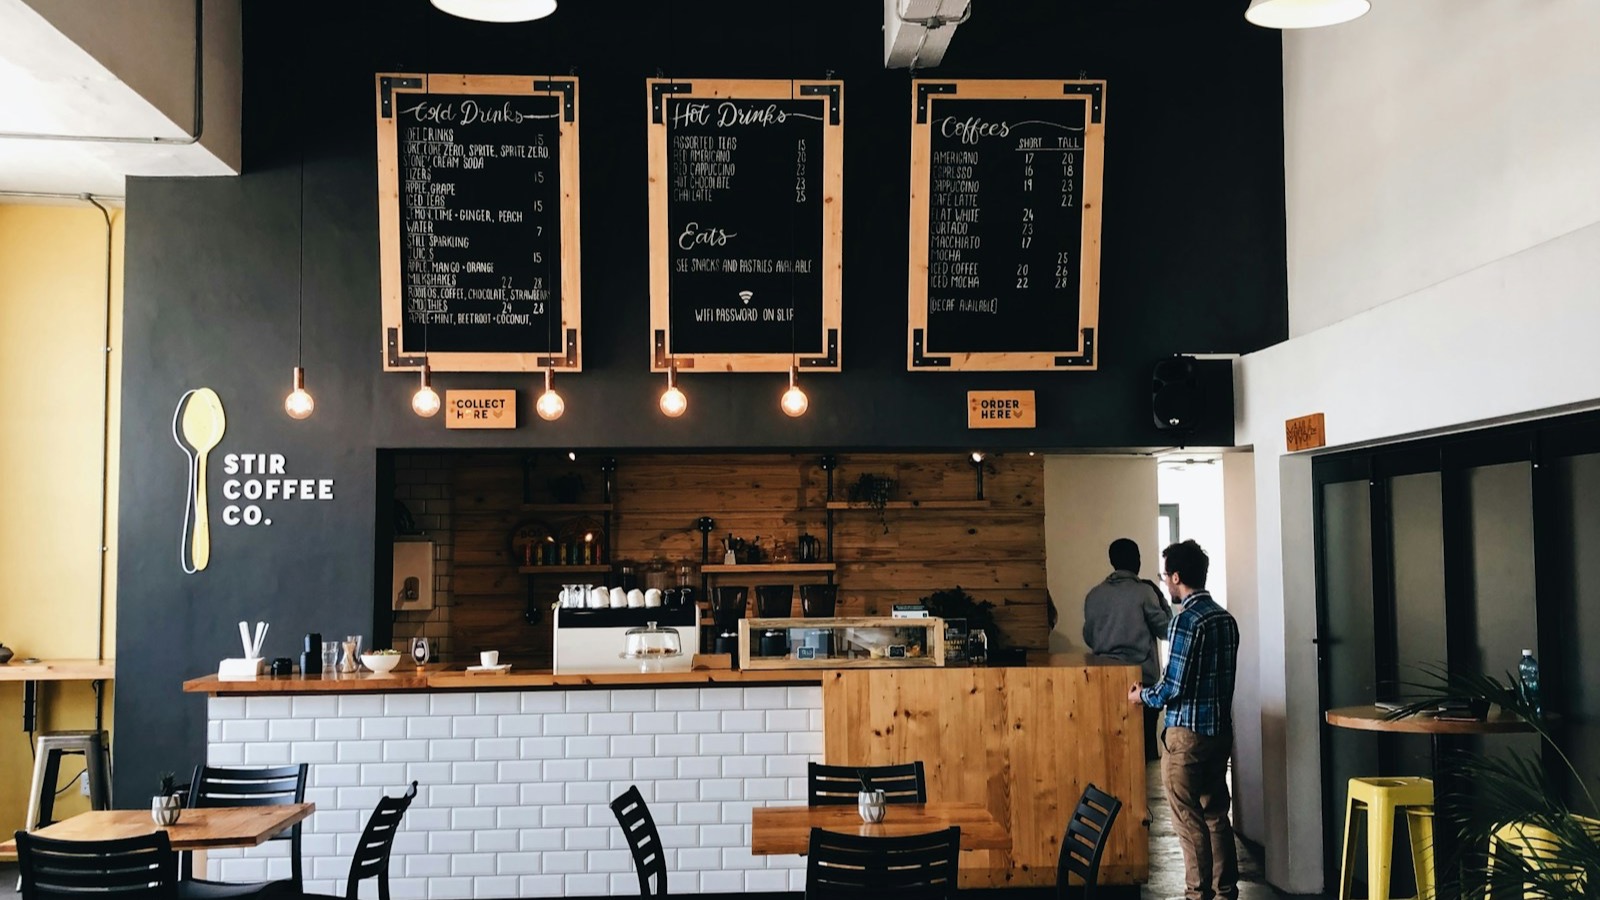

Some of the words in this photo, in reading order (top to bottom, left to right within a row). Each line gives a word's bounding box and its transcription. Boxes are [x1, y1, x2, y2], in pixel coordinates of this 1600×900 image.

[405, 102, 457, 123] Cold
[460, 100, 530, 126] Drinks
[672, 102, 711, 129] Hot
[717, 102, 790, 128] Drinks
[942, 116, 1010, 145] Coffees
[673, 136, 714, 150] ASSORTED
[718, 136, 737, 151] TEAS
[798, 139, 806, 151] 15
[1019, 137, 1042, 149] SHORT
[1058, 137, 1079, 148] TALL
[500, 145, 525, 158] SPRITE
[690, 150, 730, 163] AMERICANO
[797, 151, 807, 163] 20
[933, 151, 978, 165] AMERICANO
[1025, 153, 1034, 164] 17
[1062, 153, 1074, 165] 20
[433, 155, 459, 168] CREAM
[463, 157, 484, 169] SODA
[690, 163, 736, 176] CAPPUCCINO
[796, 163, 806, 176] 23
[933, 166, 972, 179] ESPRESSO
[1025, 165, 1034, 177] 16
[1063, 165, 1074, 177] 18
[534, 171, 544, 183] 15
[673, 176, 688, 189] HOT
[690, 176, 731, 189] CHOCOLATE
[796, 177, 806, 190] 23
[933, 179, 980, 193] CAPPUCCINO
[1024, 178, 1033, 191] 19
[1061, 180, 1073, 192] 23
[692, 189, 713, 202] LATTE
[796, 190, 807, 203] 25
[954, 194, 977, 207] LATTE
[1061, 195, 1073, 207] 22
[406, 195, 423, 207] ICED
[427, 195, 446, 207] TEAS
[533, 200, 543, 212] 15
[435, 209, 453, 221] LIME
[460, 209, 495, 223] GINGER,
[499, 210, 523, 223] PEACH
[955, 208, 980, 223] WHITE
[1022, 208, 1034, 222] 24
[406, 220, 434, 233] WATER
[537, 226, 543, 237] 7
[931, 222, 968, 235] CORTADO
[1022, 223, 1033, 235] 23
[406, 235, 425, 247] STILL
[429, 236, 470, 249] SPARKLING
[678, 222, 737, 250] Eats
[931, 236, 980, 249] MACCHIATO
[1021, 237, 1032, 249] 17
[408, 247, 434, 260] JUICS
[533, 252, 542, 263] 15
[931, 250, 961, 262] MOCHA
[1057, 252, 1068, 264] 25
[432, 261, 460, 273] MANGO
[466, 261, 494, 273] ORANGE
[676, 258, 689, 272] SEE
[691, 258, 720, 272] SNACKS
[722, 259, 738, 273] AND
[740, 259, 773, 273] PASTRIES
[931, 263, 949, 275] ICED
[951, 262, 978, 276] COFFEE
[1017, 264, 1029, 276] 20
[1055, 265, 1068, 277] 26
[407, 273, 456, 286] MILKSHAKES
[502, 276, 512, 289] 22
[534, 277, 542, 289] 28
[931, 276, 948, 288] ICED
[951, 275, 980, 288] MOCHA
[1016, 277, 1029, 289] 22
[1055, 277, 1068, 289] 28
[502, 301, 512, 314] 24
[533, 302, 544, 315] 28
[695, 308, 714, 322] WIFI
[716, 308, 758, 322] PASSWORD
[763, 308, 775, 321] ON
[458, 313, 491, 325] BEETROOT
[496, 313, 532, 326] COCONUT,
[456, 399, 505, 408] COLLECT
[981, 399, 1019, 409] ORDER
[457, 410, 488, 419] HRE
[981, 410, 1011, 419] HERE
[224, 453, 286, 475] STIR
[223, 479, 334, 500] COFFEE
[222, 504, 272, 526] CO.
